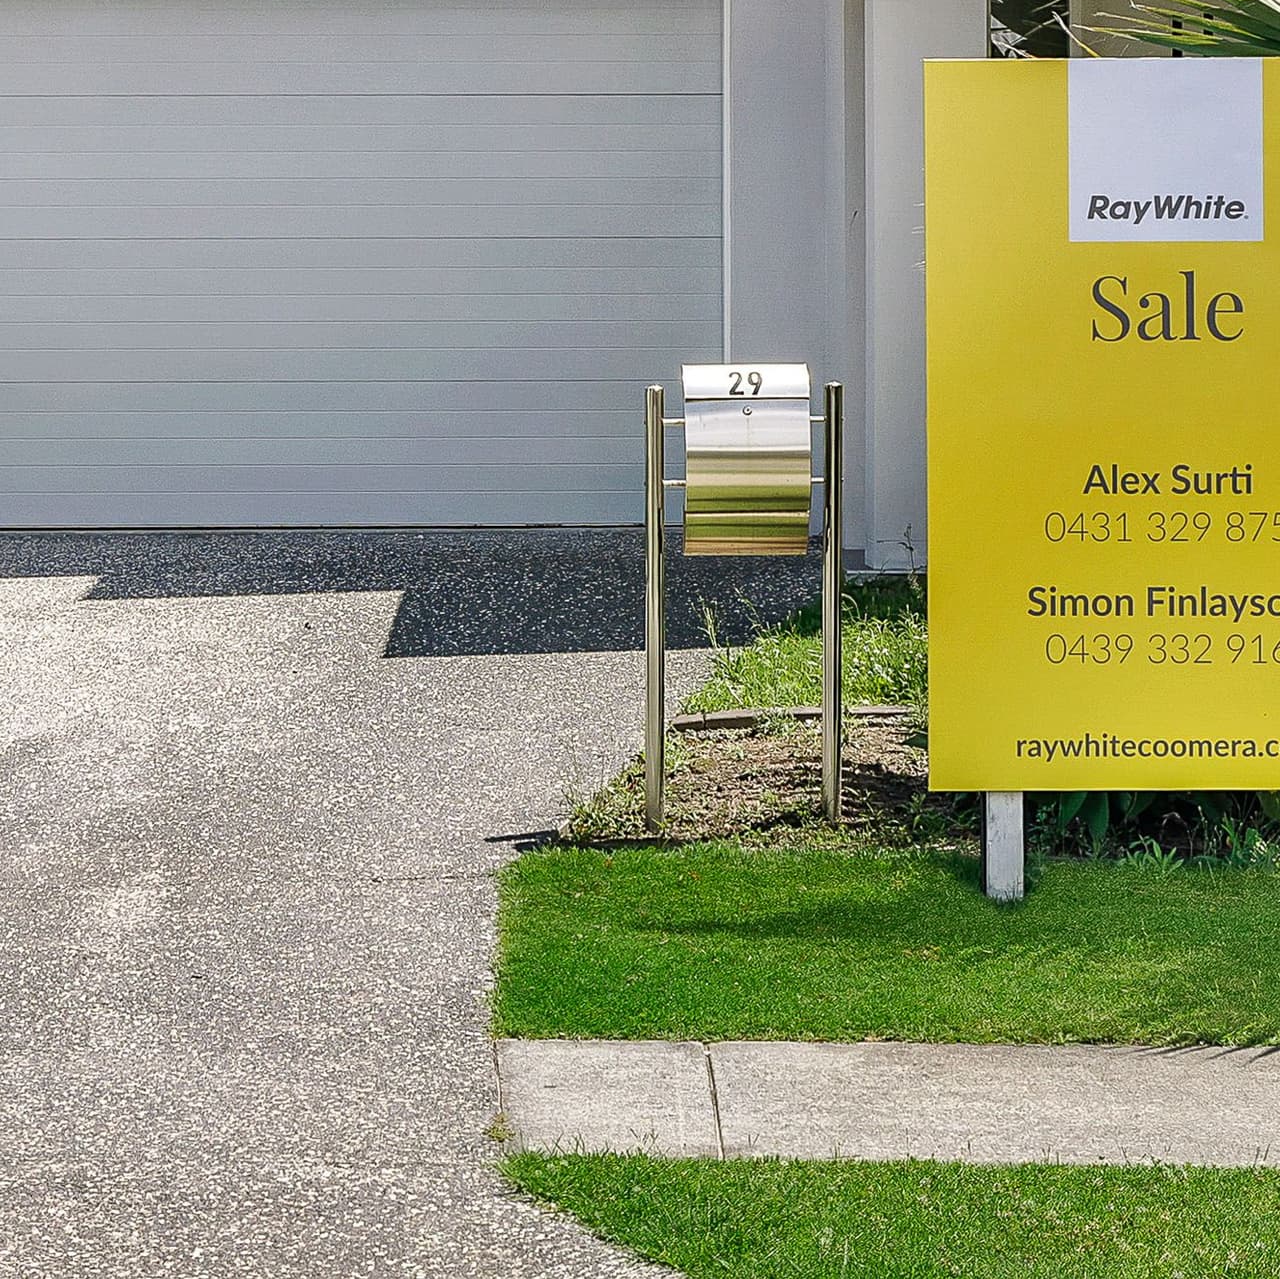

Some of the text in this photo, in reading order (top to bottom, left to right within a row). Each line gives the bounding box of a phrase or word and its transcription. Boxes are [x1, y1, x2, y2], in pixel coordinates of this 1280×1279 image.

[1092, 270, 1244, 342] Sale
[729, 371, 763, 396] 29
[1082, 463, 1253, 495] Alex Surti
[1044, 512, 1132, 543] 0431
[1147, 511, 1211, 542] 329
[1027, 586, 1134, 617] Simon
[1045, 633, 1133, 664] 0439
[1147, 633, 1213, 664] 332
